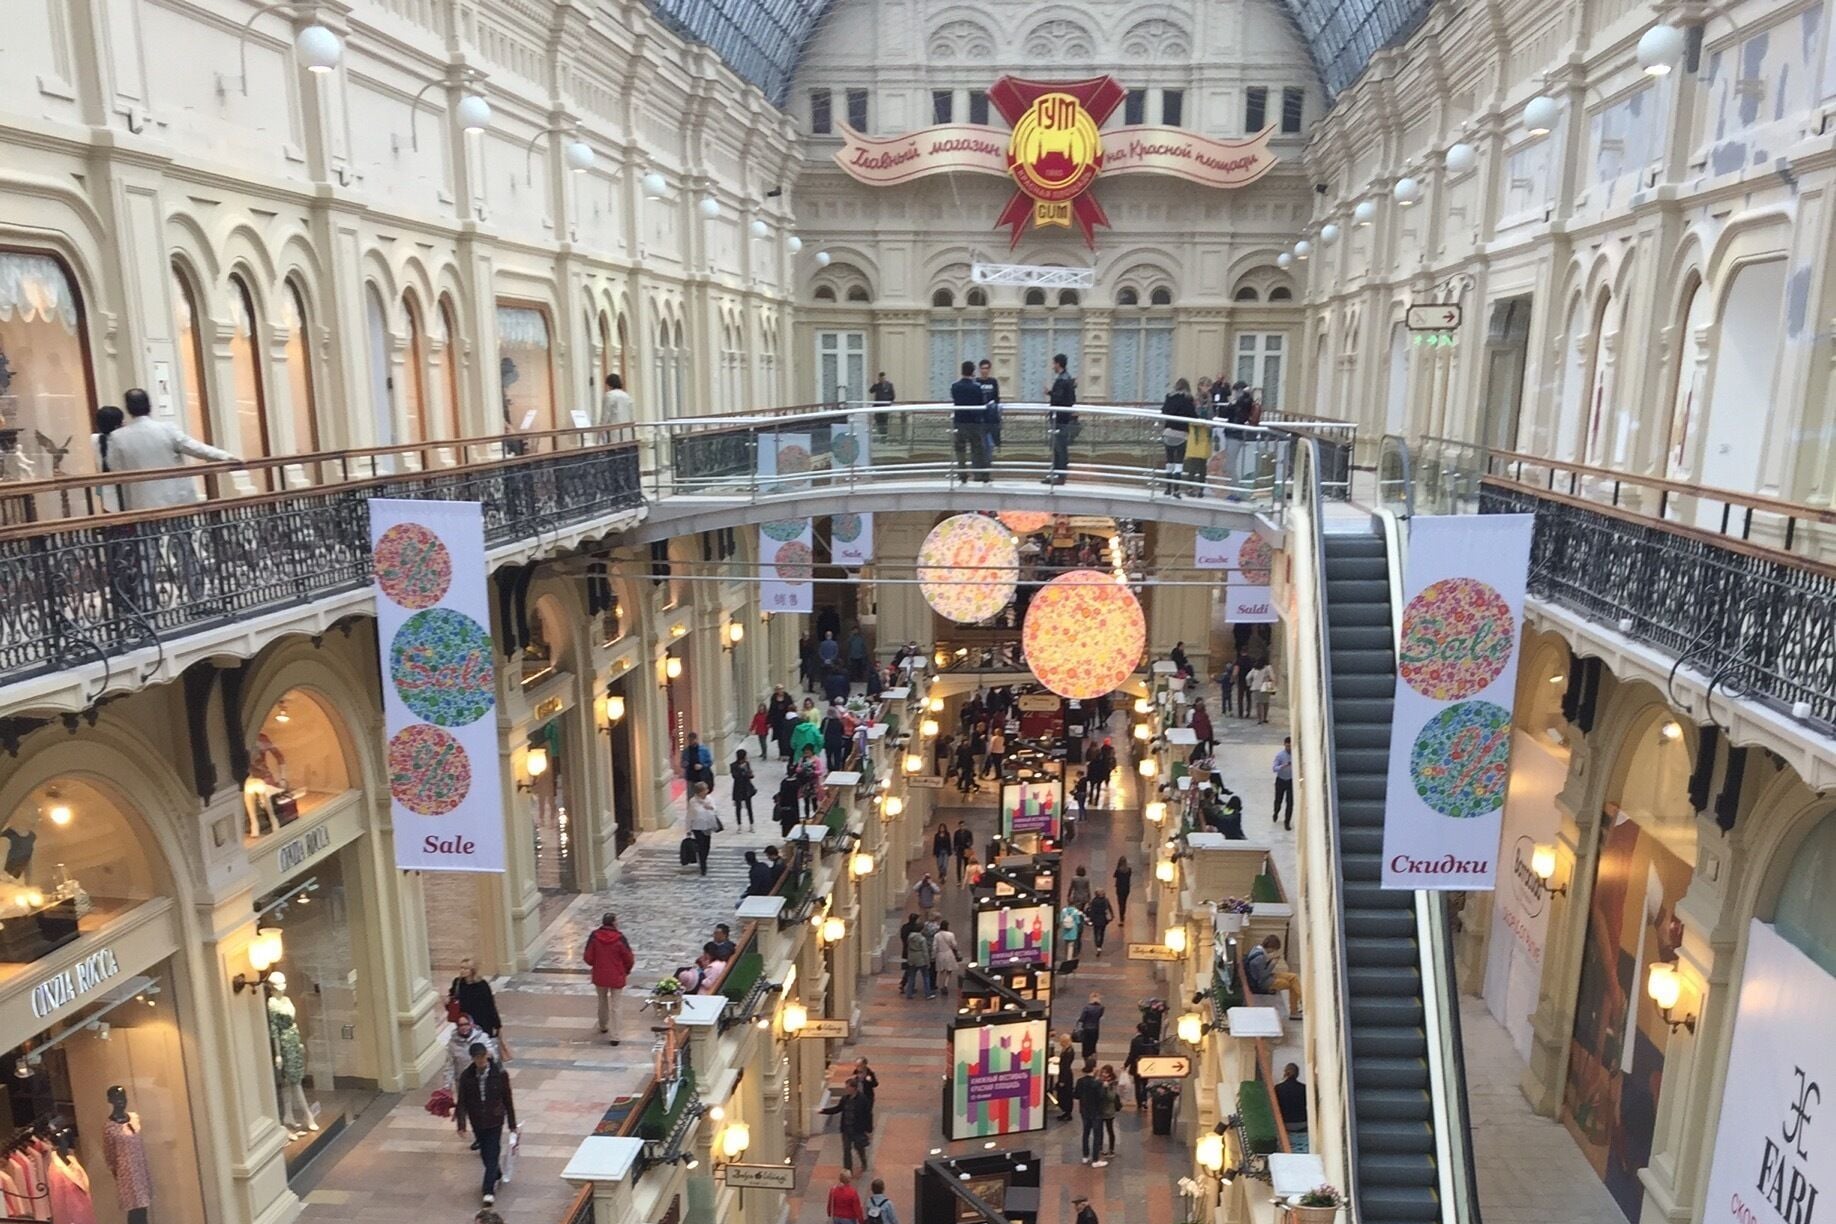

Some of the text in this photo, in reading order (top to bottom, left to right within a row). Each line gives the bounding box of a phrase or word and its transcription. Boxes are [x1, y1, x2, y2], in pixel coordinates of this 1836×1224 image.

[1038, 97, 1077, 131] ГУМ
[850, 139, 1259, 174] Главный магазин на Красной площади
[423, 835, 475, 855] Sale
[1391, 854, 1488, 874] Скидки
